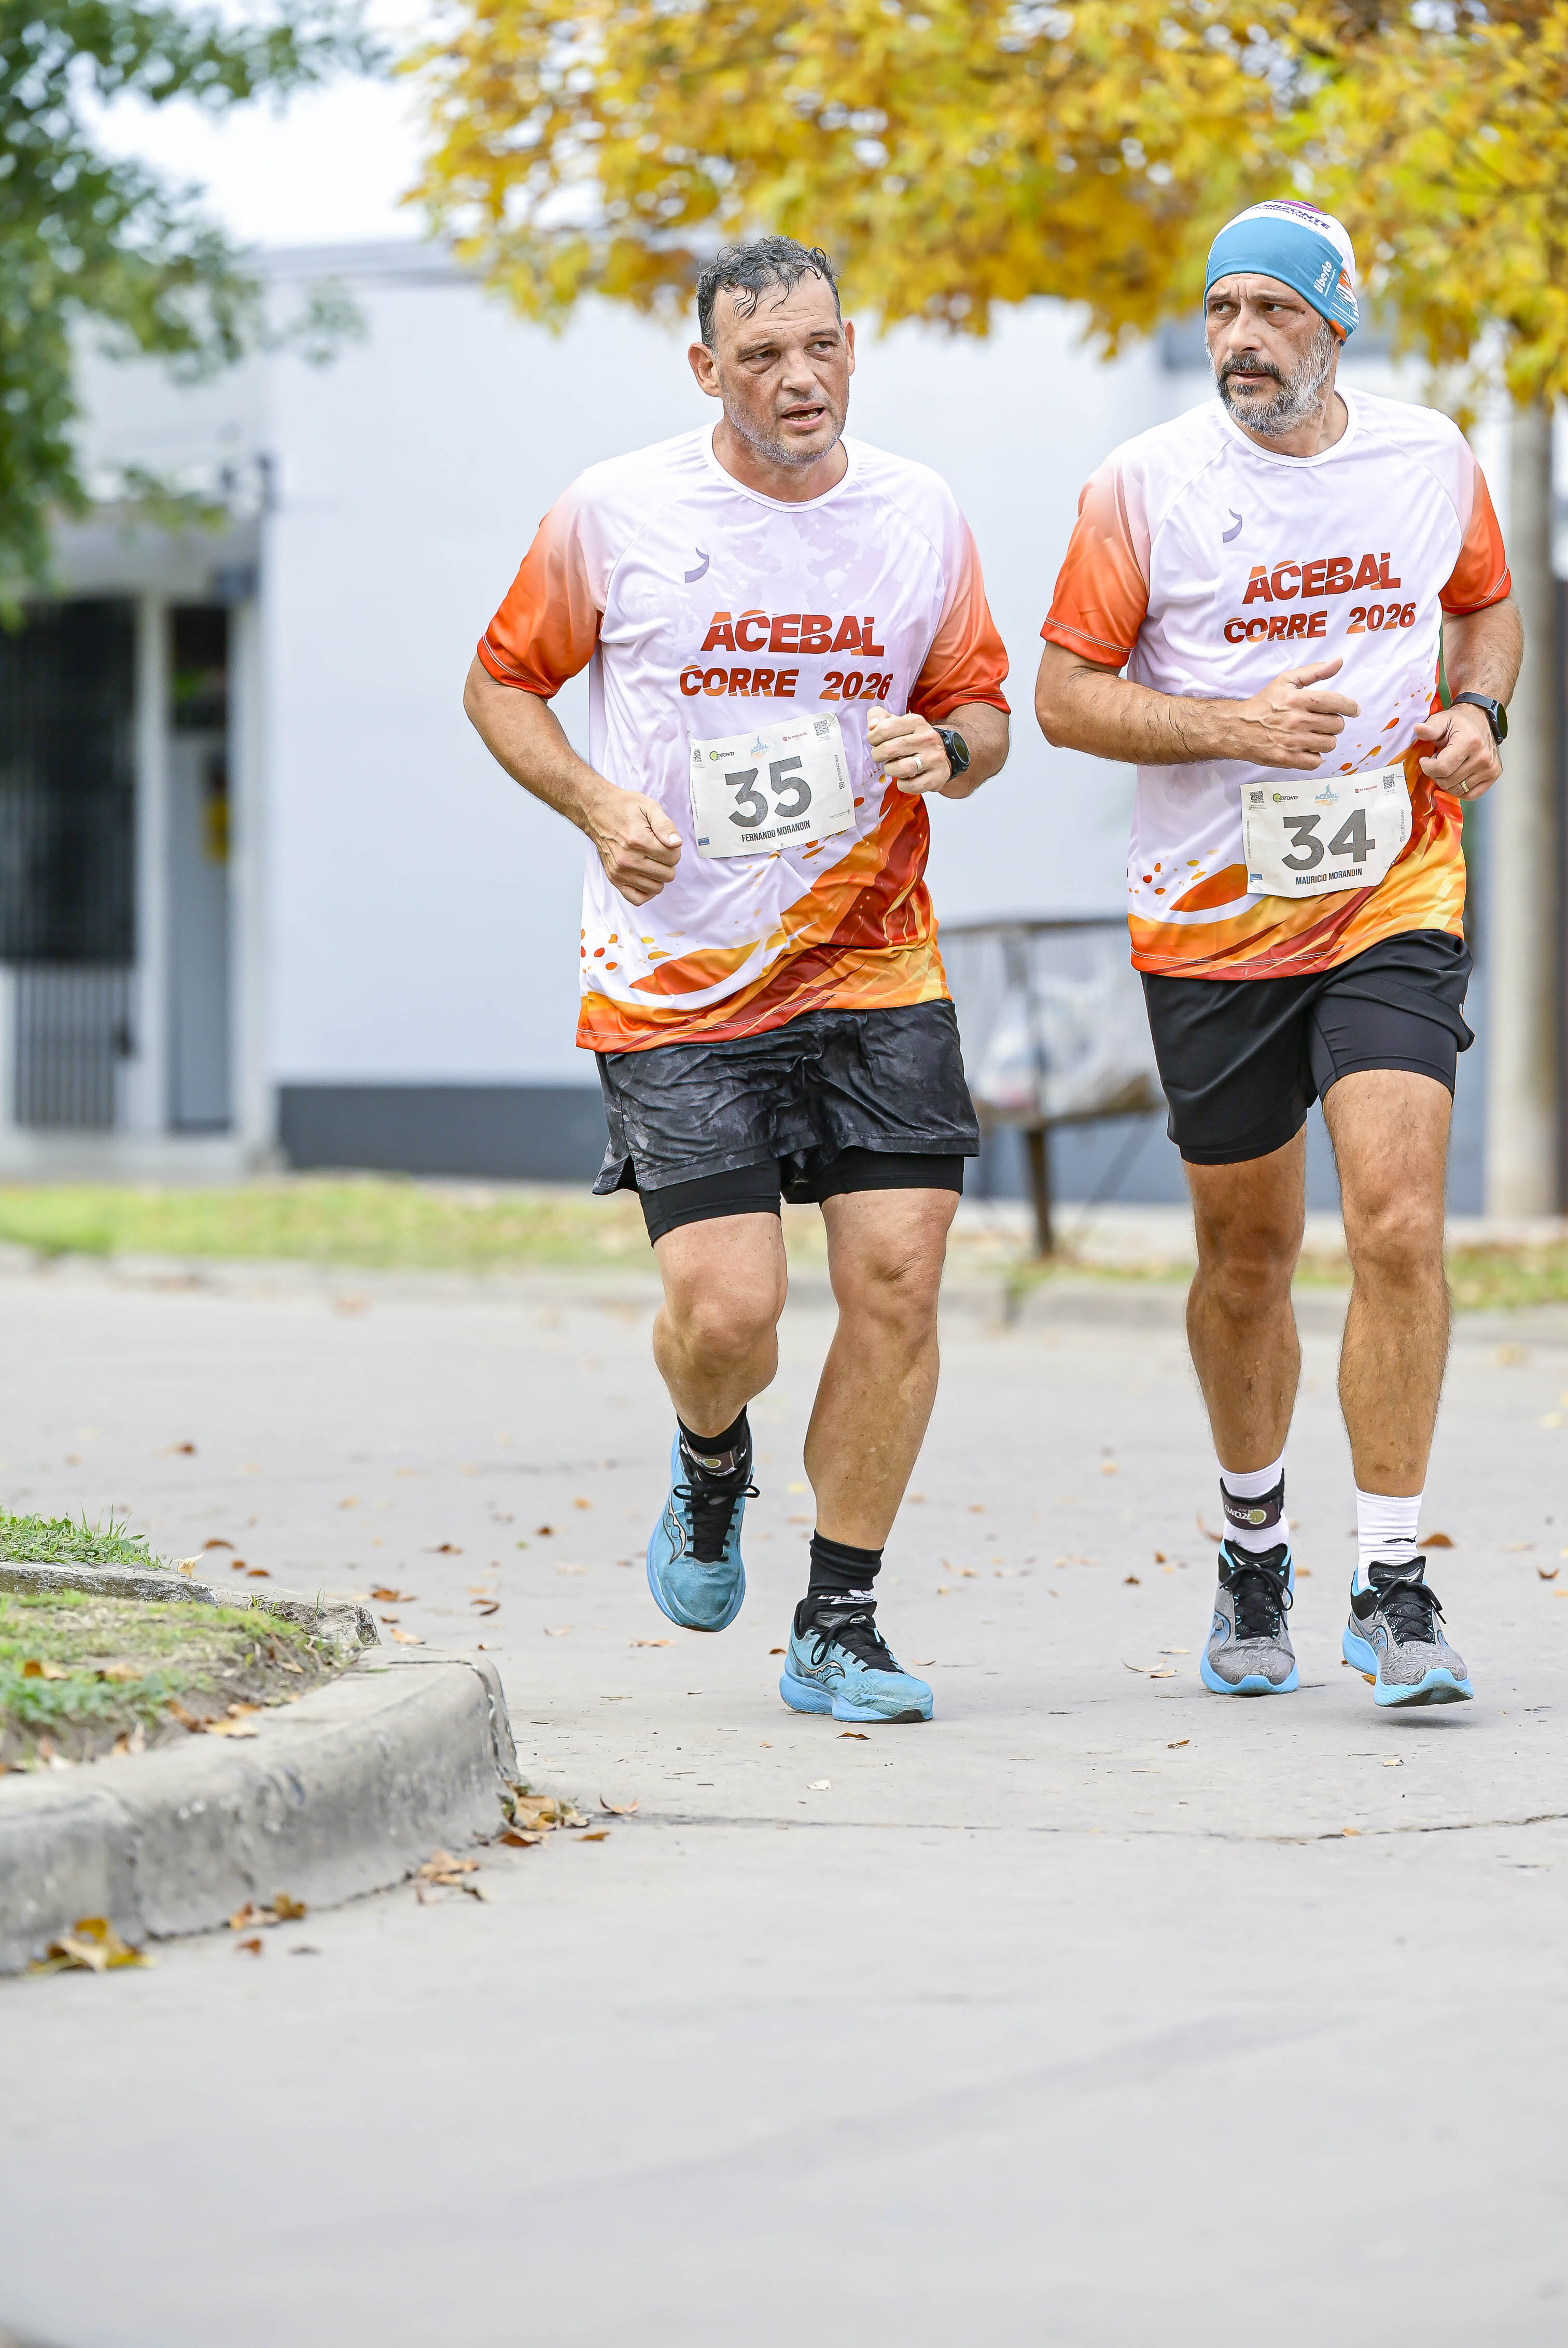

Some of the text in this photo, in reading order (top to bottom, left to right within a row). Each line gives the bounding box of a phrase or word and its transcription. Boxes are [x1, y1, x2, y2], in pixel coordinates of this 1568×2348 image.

[1242, 552, 1401, 604] ACEBAL
[700, 609, 885, 657] ACEBAL
[1224, 603, 1416, 644] CORRE 2026
[679, 665, 893, 701] CORRE 2026
[724, 756, 812, 828] 35
[741, 820, 810, 843] FERNANDO MORANDIN
[1282, 809, 1375, 871] 34
[1296, 868, 1363, 885] MAURICIO MORANDIN
